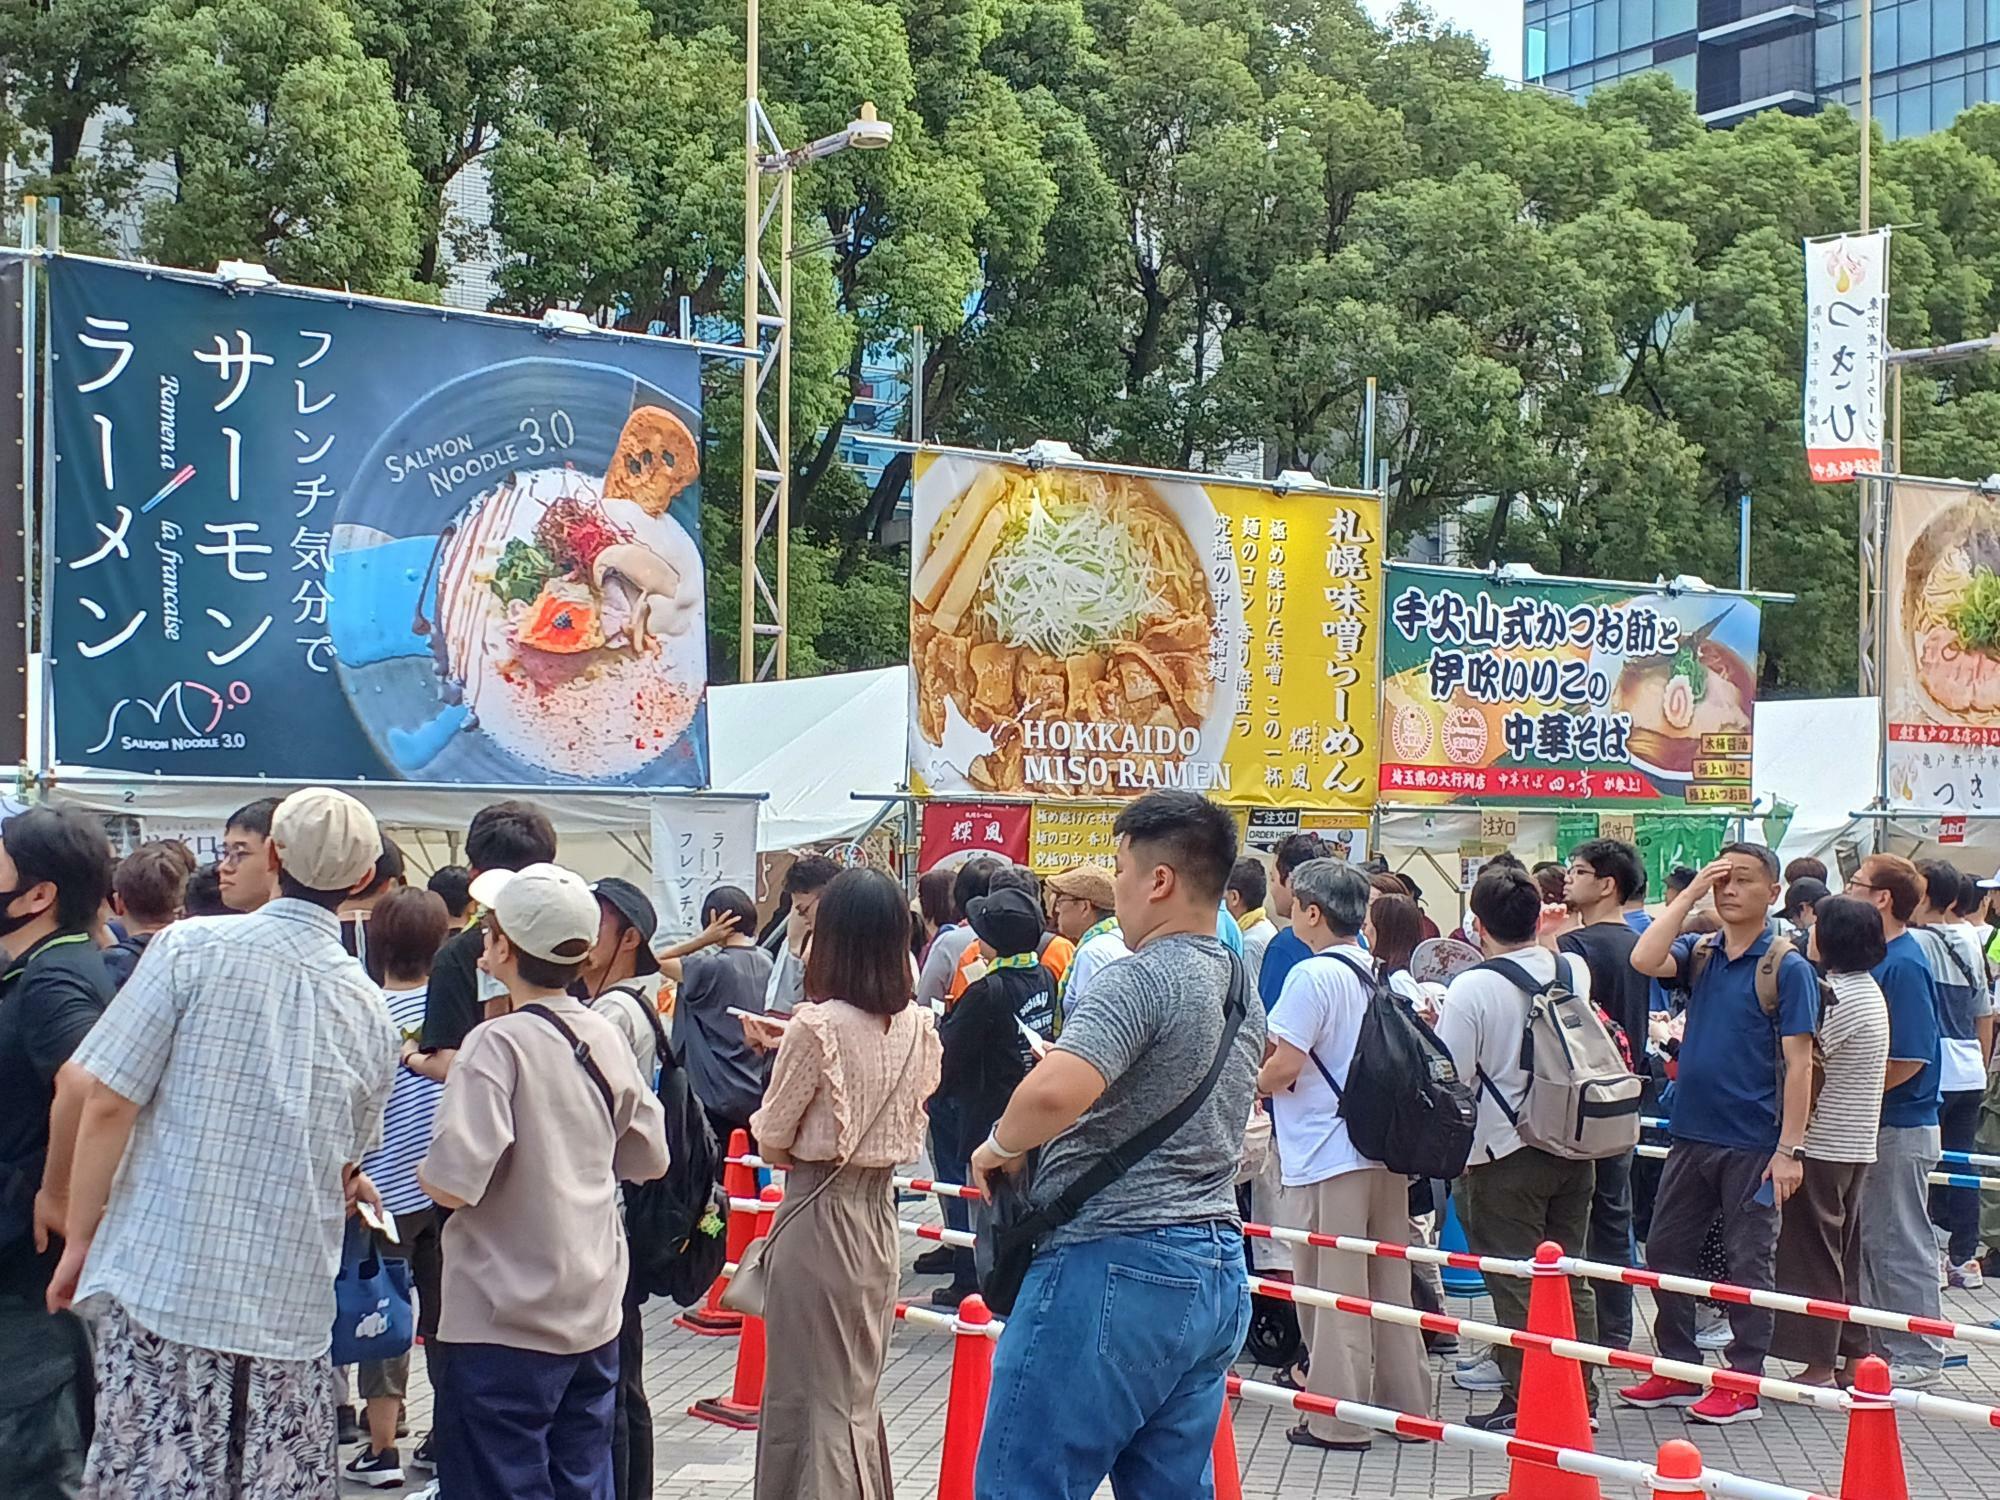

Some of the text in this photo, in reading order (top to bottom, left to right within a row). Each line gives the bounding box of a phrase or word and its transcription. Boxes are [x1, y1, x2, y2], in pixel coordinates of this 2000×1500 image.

[518, 408, 576, 457] 3.0
[67, 314, 149, 661] ラーメン
[154, 374, 185, 643] Ramen a la francaise
[192, 328, 276, 667] サーモン
[291, 329, 339, 673] フレンチ気分で
[1239, 514, 1262, 614] 麺のコシ
[1393, 586, 1683, 658] 手火山式かつお節と
[1263, 518, 1290, 791] 極め続けた味噌 この一杯
[1320, 507, 1374, 795] 札幌味噌らーめん
[1428, 650, 1612, 706] 伊吹いりこの
[220, 732, 246, 749] 3.0
[1022, 718, 1202, 757] HOKKAIDO
[1502, 712, 1632, 764] 中華そば
[1023, 755, 1232, 791] MISO RAMEN
[1391, 768, 1487, 790] 埼玉県の大行列店
[1498, 772, 1545, 790] 中華そば
[1698, 761, 1746, 777] 極上いりこ
[124, 791, 134, 802] 2
[1252, 811, 1296, 825] ご注文口
[1249, 830, 1274, 839] ORDER
[1424, 819, 1432, 829] 4
[1482, 816, 1516, 836] 注文口
